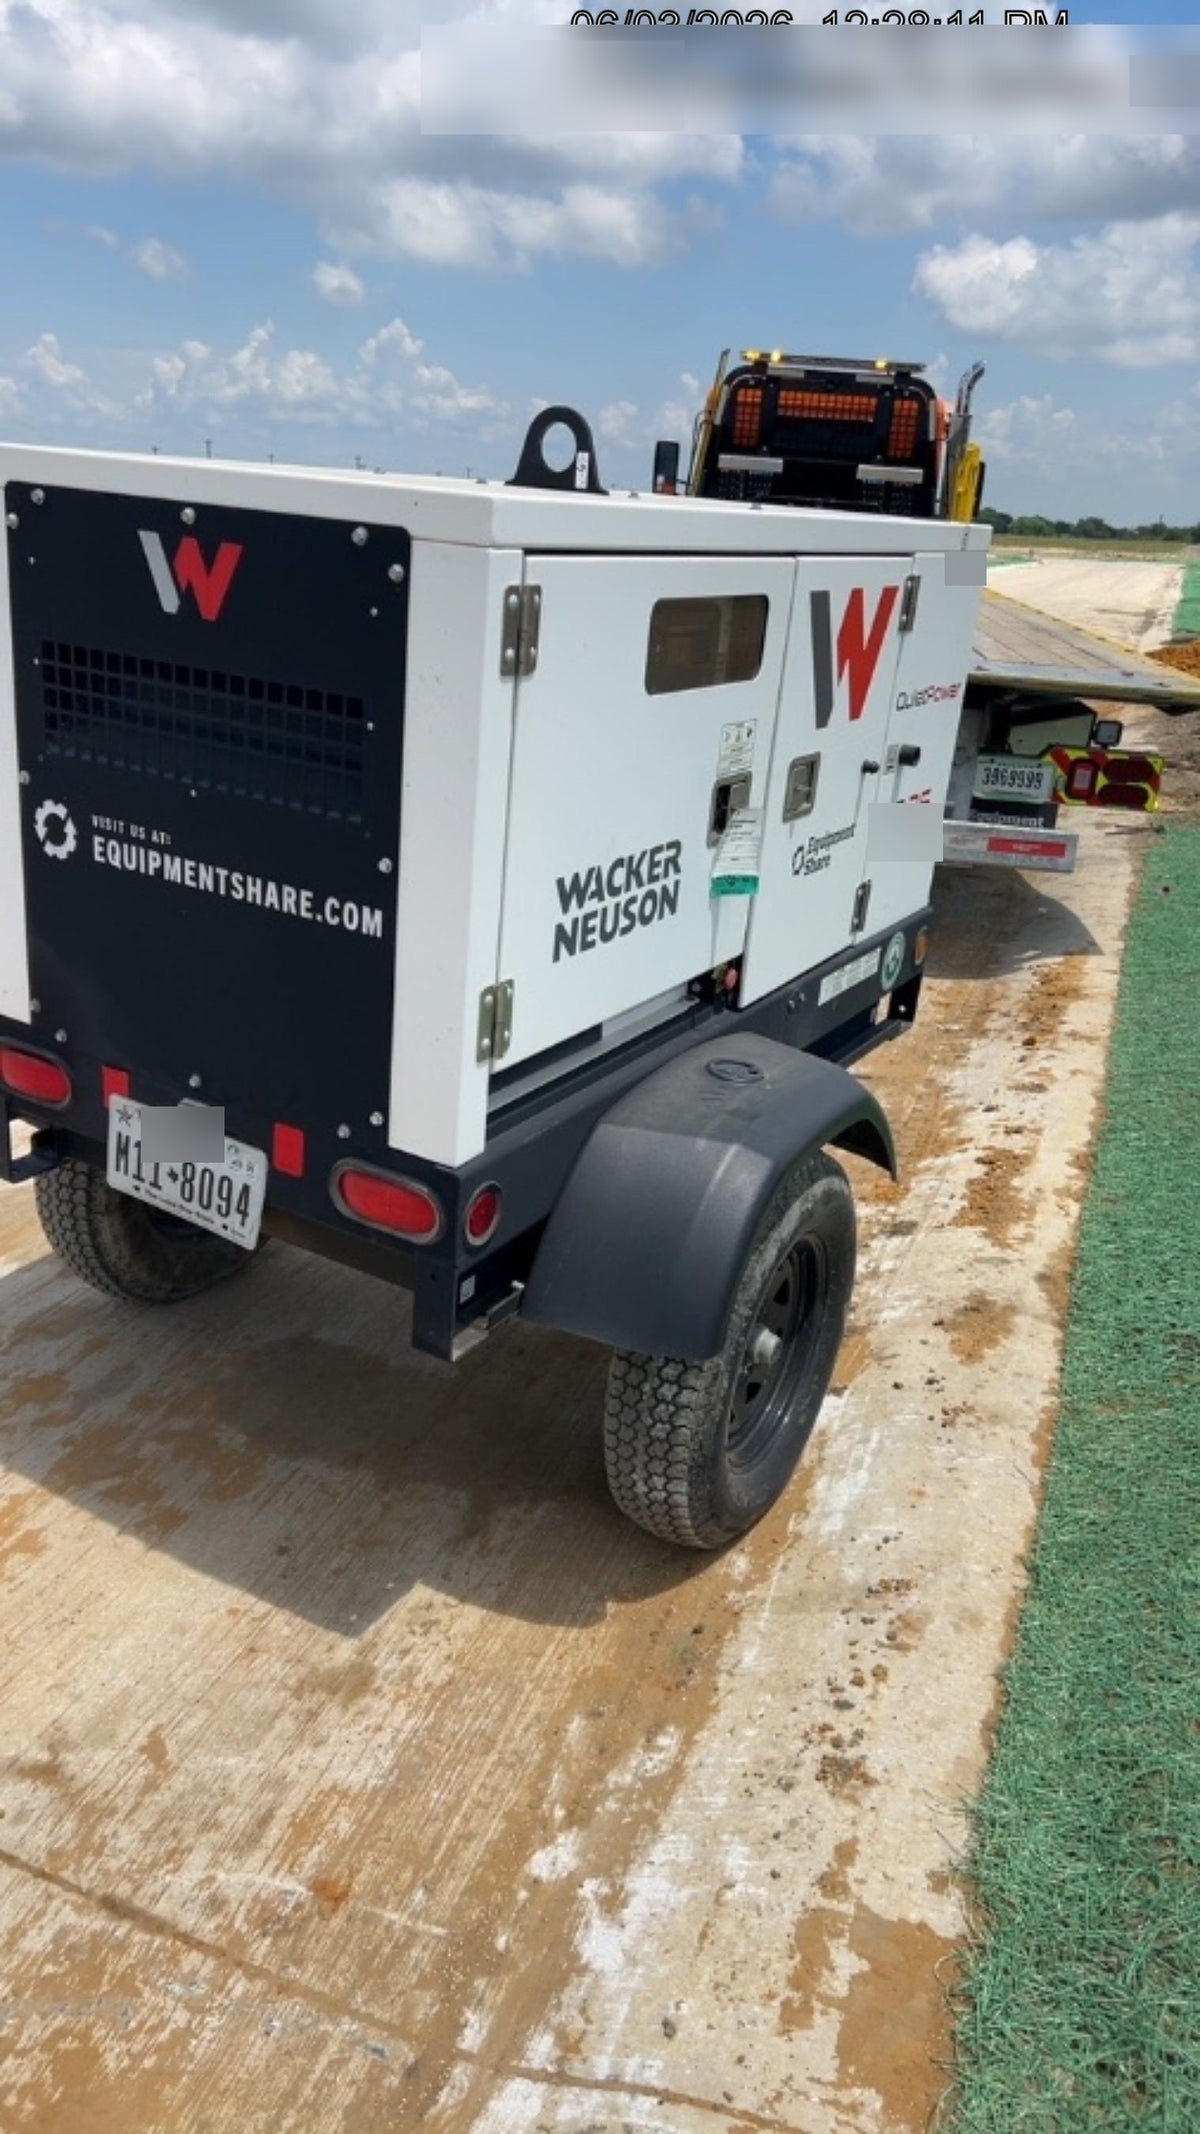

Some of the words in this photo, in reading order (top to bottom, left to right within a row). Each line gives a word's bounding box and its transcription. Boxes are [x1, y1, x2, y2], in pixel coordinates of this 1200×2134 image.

[92, 814, 125, 833] VISIT
[130, 824, 146, 839] US
[92, 834, 383, 938] EQUIPMENTSHARE.COM
[556, 839, 682, 915] WACKER
[552, 879, 681, 963] NEUSON
